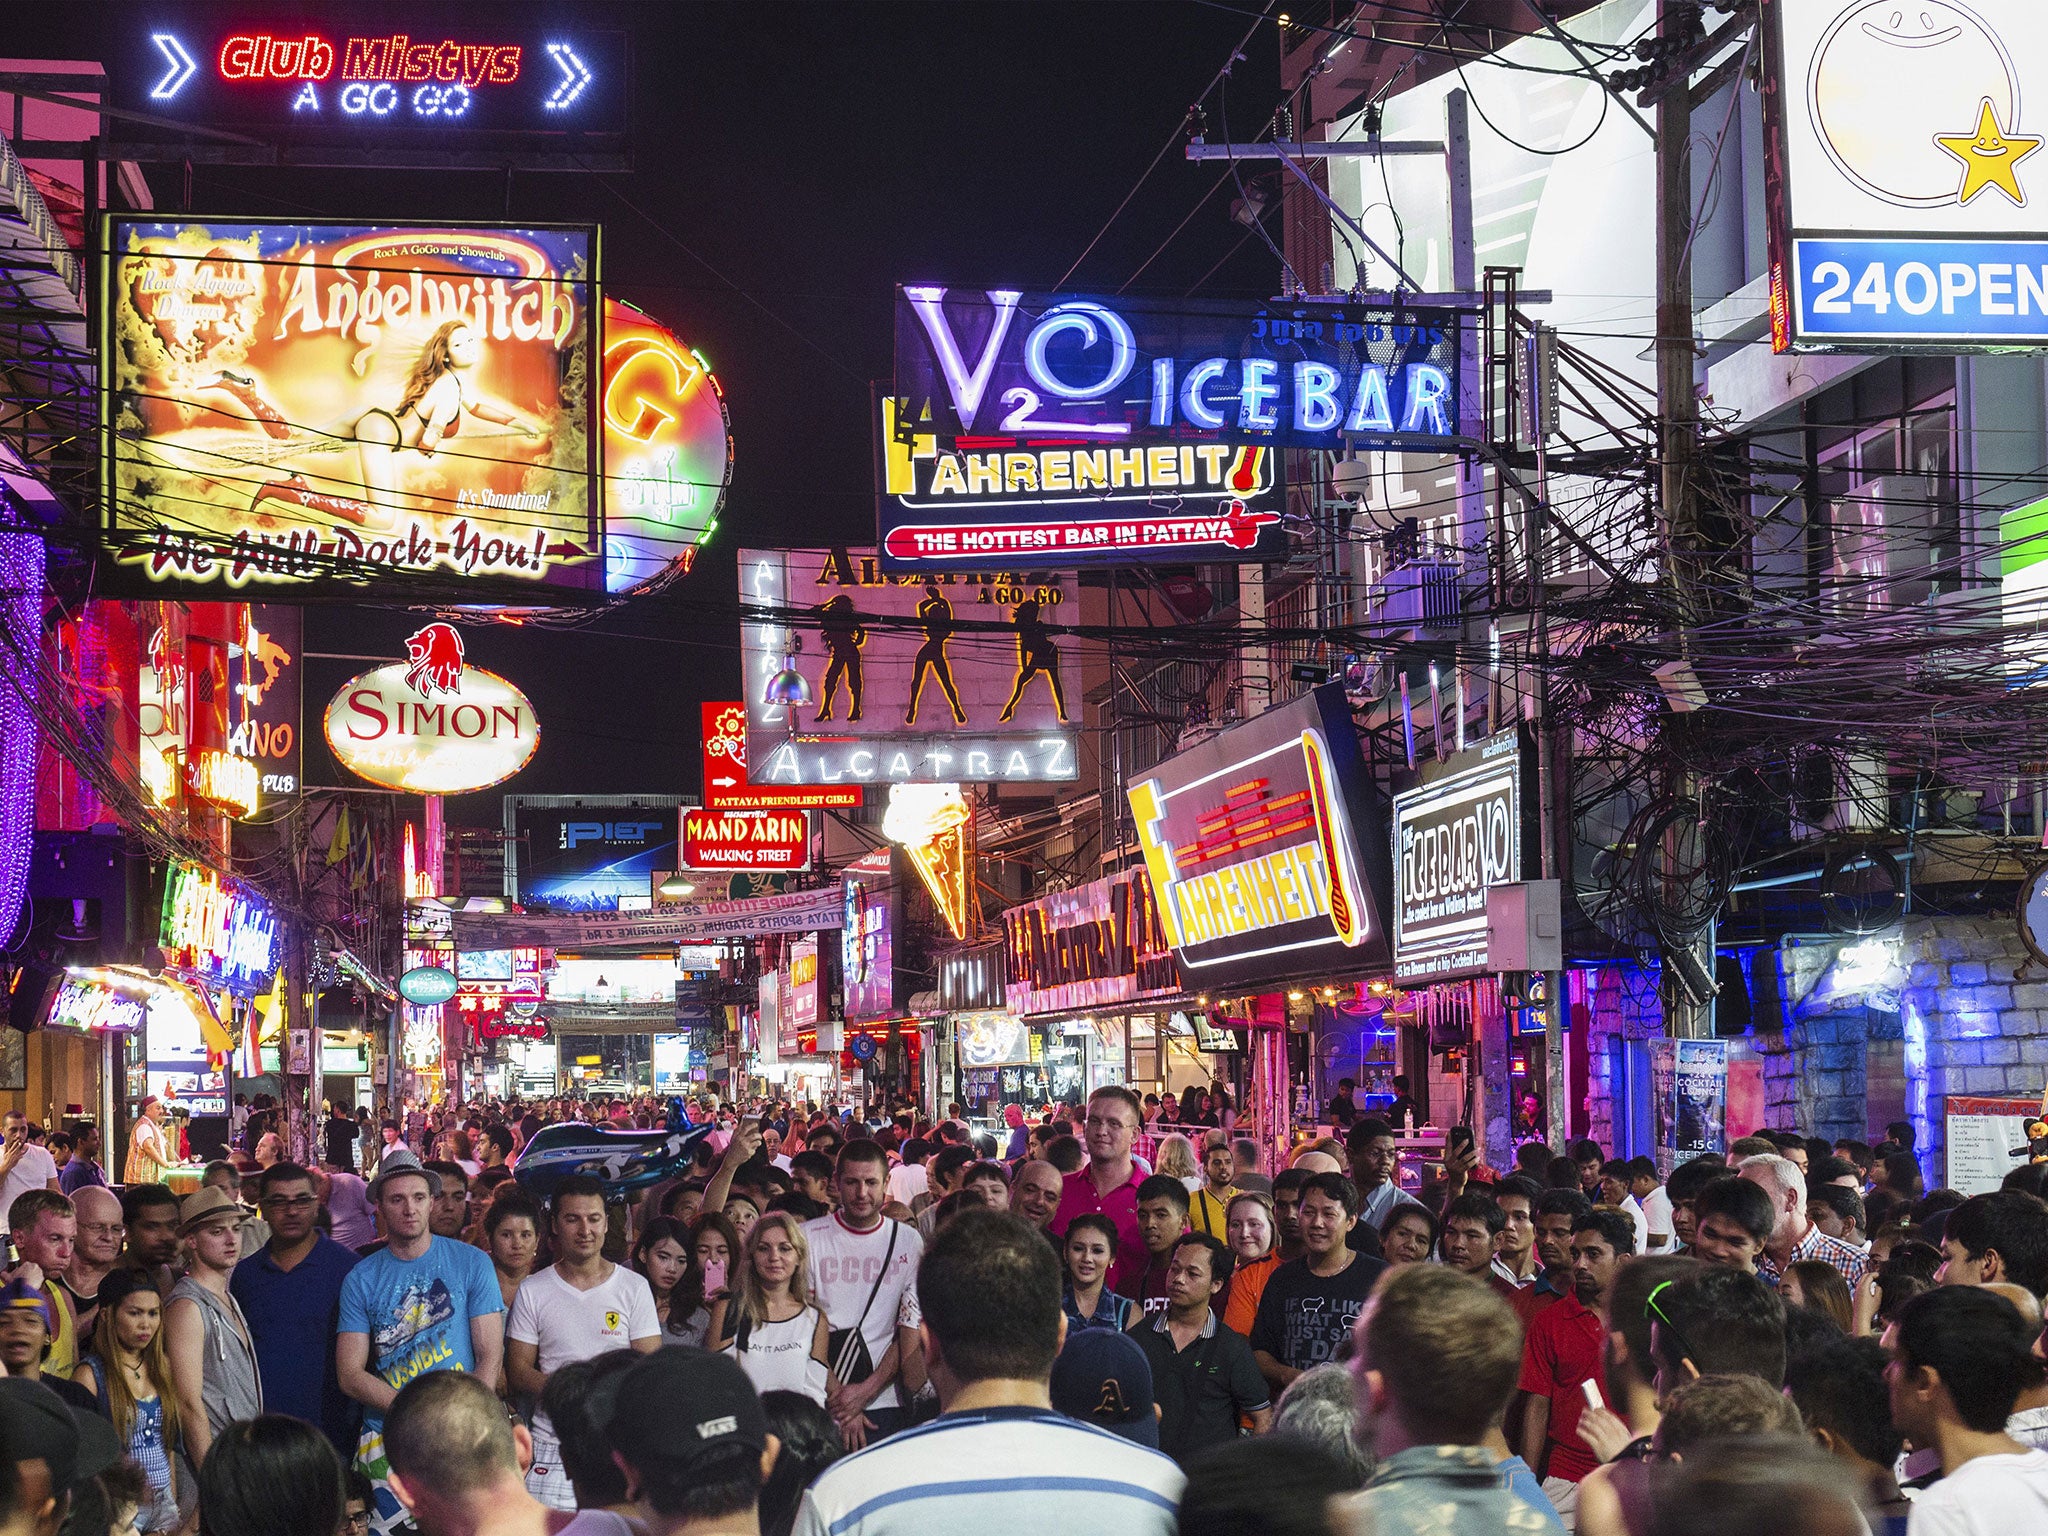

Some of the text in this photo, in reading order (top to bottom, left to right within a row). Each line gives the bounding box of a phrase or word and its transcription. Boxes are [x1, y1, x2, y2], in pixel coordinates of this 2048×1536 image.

[220, 35, 521, 88] Club Mistys
[294, 82, 470, 115] A GO GO
[374, 244, 506, 262] Rock A GoGo and Showclub
[142, 269, 182, 291] Rock
[272, 249, 574, 377] Angelwitch
[882, 396, 1230, 496] FAHRENHEIT
[455, 488, 480, 510] It's
[914, 521, 1234, 552] THE HOTTEST BAR IN PATTAYA
[150, 525, 214, 575] We
[450, 518, 546, 576] You!
[977, 586, 1064, 606] A GO GO
[345, 689, 521, 741] SIMON
[771, 738, 1074, 784] ALCATRAZ
[262, 775, 294, 793] PUB
[714, 795, 855, 807] PATTAYA FRIENDLIEST GIRLS
[699, 849, 792, 864] WALKING STREET
[1127, 777, 1331, 950] FAHRENHEIT
[1445, 894, 1466, 915] Walking
[1474, 950, 1488, 966] Loun
[1677, 1078, 1725, 1088] COCKTAIL
[1681, 1087, 1721, 1096] LOUNGE
[1688, 1140, 1704, 1149] -15
[1331, 1299, 1362, 1315] LIK
[1285, 1312, 1333, 1327] WHAT
[1284, 1326, 1325, 1340] JUST
[765, 1345, 773, 1353] IT
[774, 1342, 802, 1353] AGAIN
[696, 1415, 738, 1440] VANS
